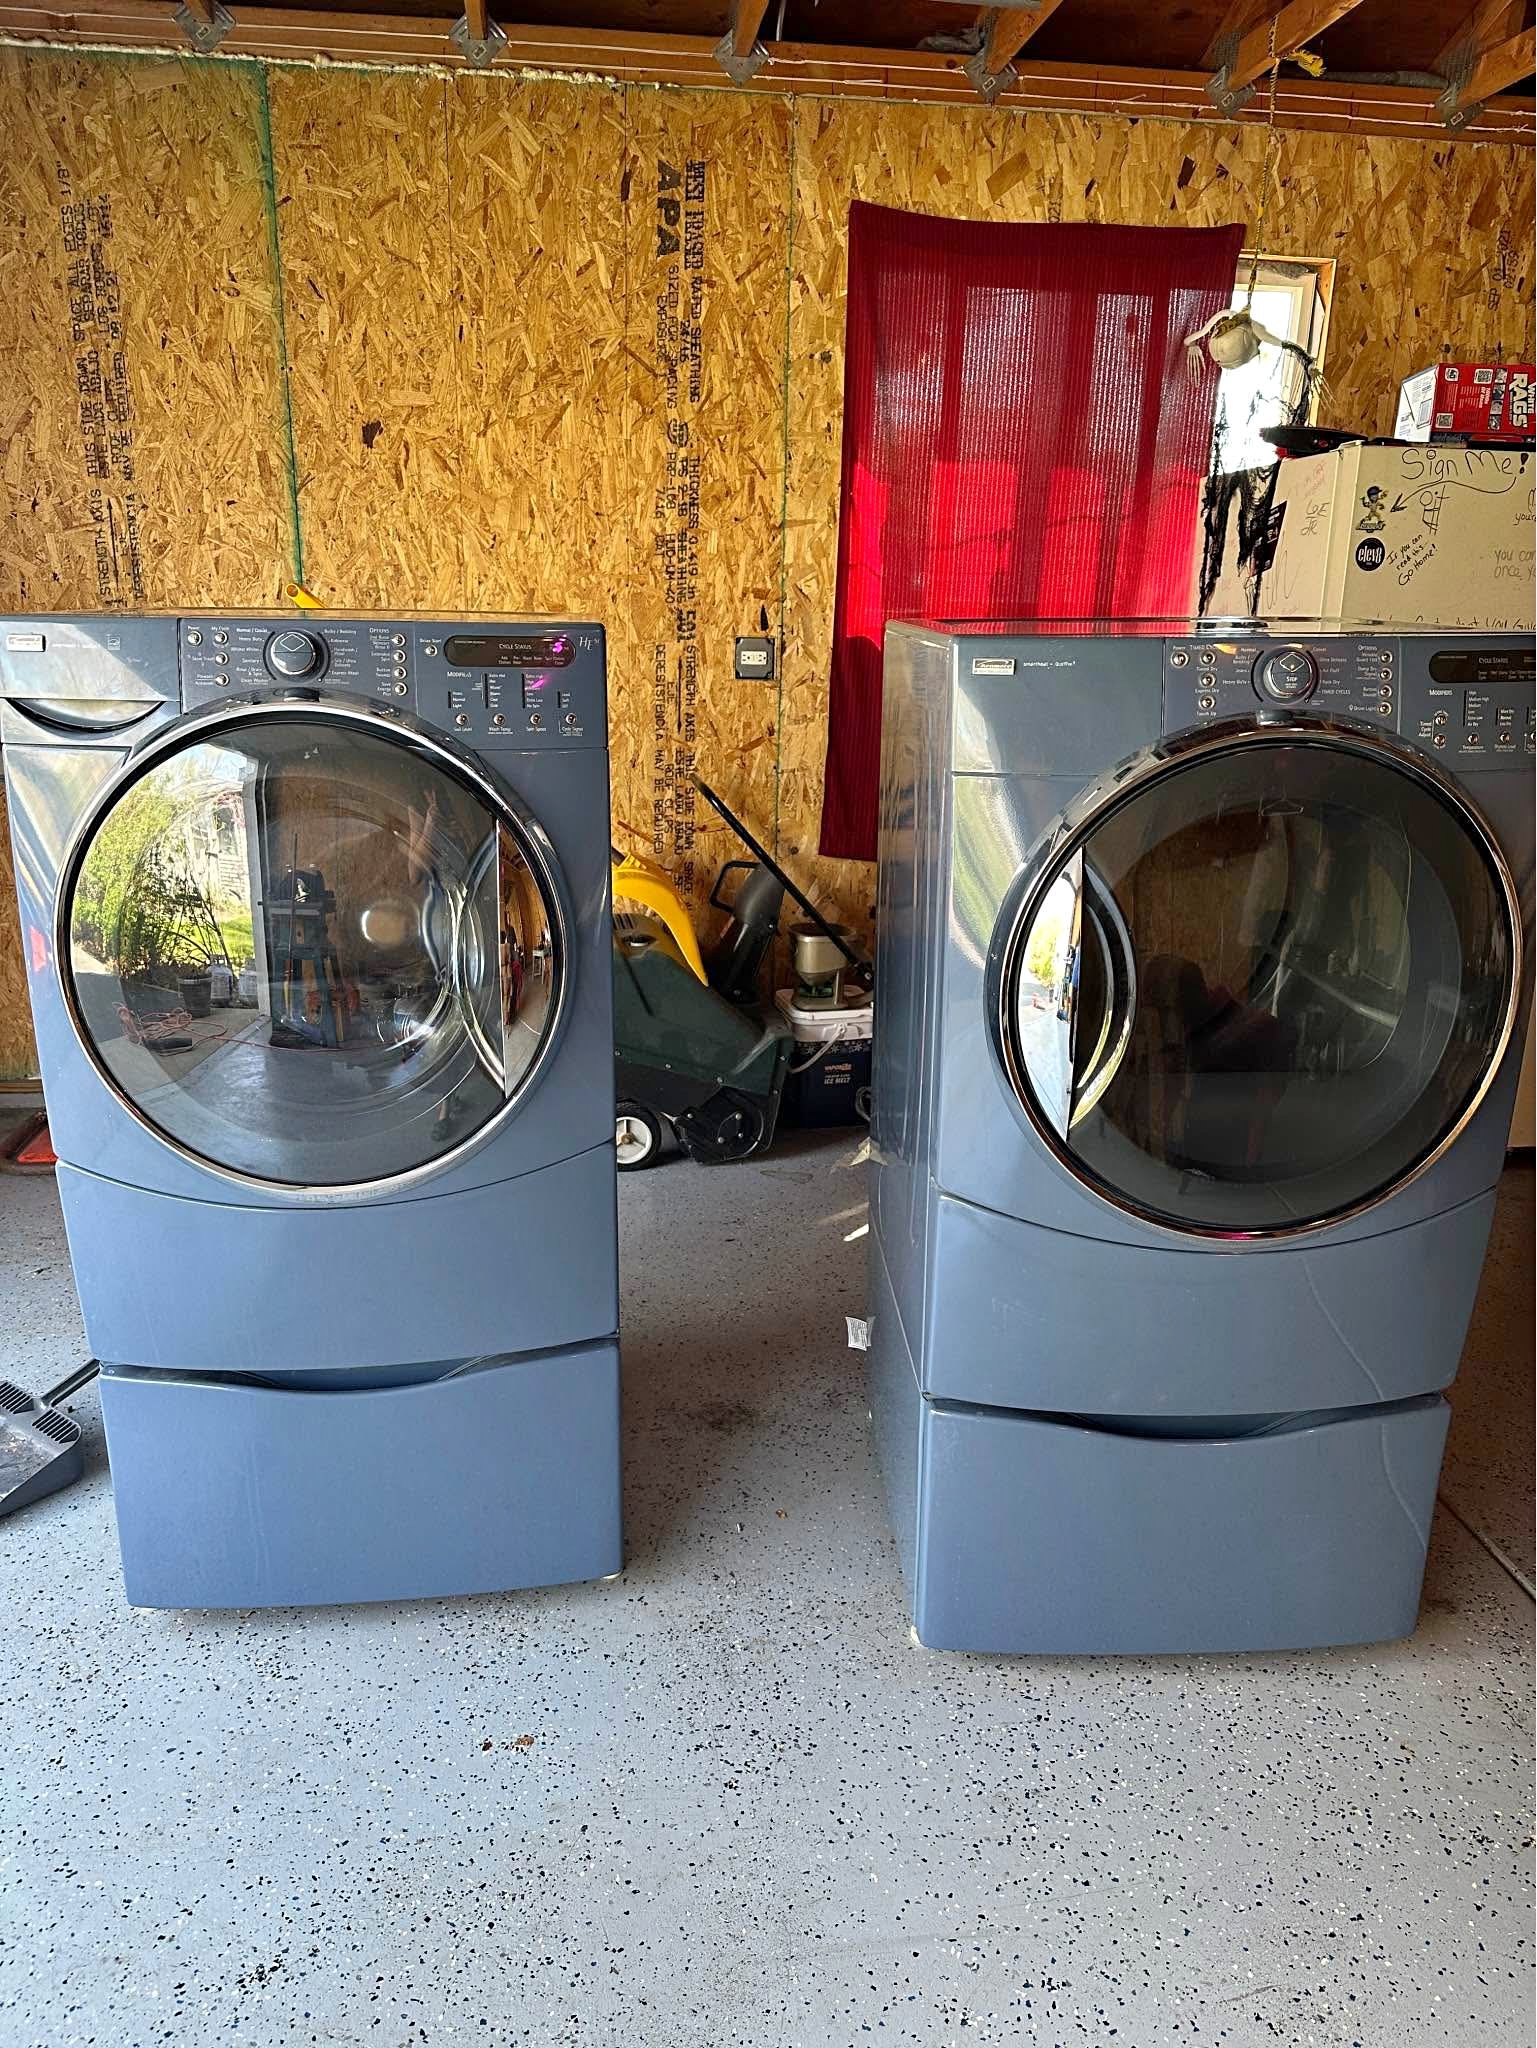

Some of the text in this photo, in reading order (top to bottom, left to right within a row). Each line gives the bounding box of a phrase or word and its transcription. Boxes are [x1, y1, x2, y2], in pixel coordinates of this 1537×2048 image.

[657, 160, 681, 257] APA
[67, 259, 80, 289] ALL
[668, 265, 679, 309] SIZED
[70, 297, 86, 342] SPACE
[667, 317, 679, 342] FOR
[689, 276, 702, 404] RATED SHEATHING
[76, 356, 91, 396] DOWN
[1509, 373, 1528, 428] RAGS
[1527, 382, 1537, 414] WHITE
[80, 400, 95, 437] SIDE
[84, 442, 98, 477] THIS
[1401, 449, 1459, 487] Sign
[90, 488, 105, 523] AXIS
[689, 455, 701, 528] THICKNESS
[94, 528, 111, 596] STRENGTH
[688, 535, 698, 576] 0.419
[685, 645, 697, 707] STRENGTH
[685, 712, 696, 743] AXIS
[685, 751, 696, 781] THIS
[653, 748, 666, 855] MAY BE REQUIRED
[664, 763, 675, 834] ROOF CLIPS
[684, 786, 695, 816] SIDE
[684, 822, 695, 851] DOWN
